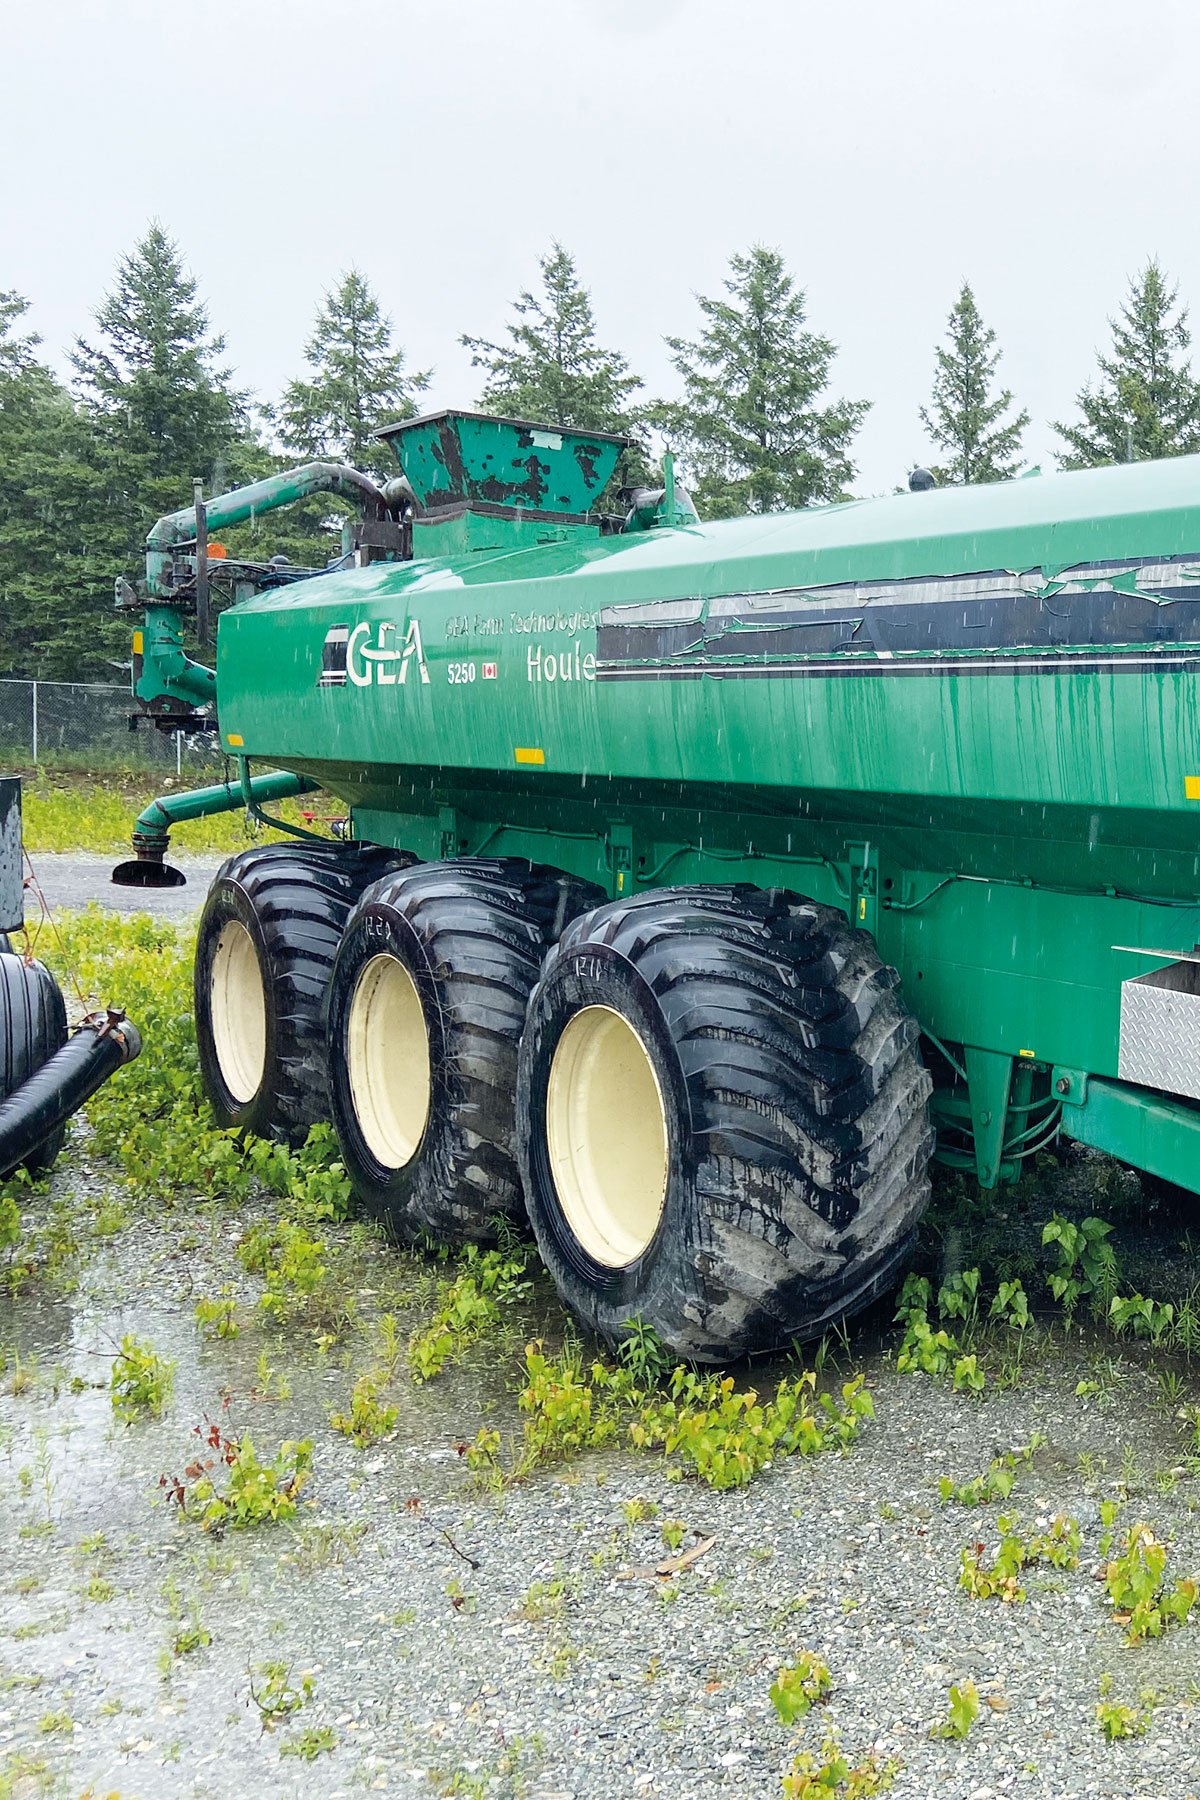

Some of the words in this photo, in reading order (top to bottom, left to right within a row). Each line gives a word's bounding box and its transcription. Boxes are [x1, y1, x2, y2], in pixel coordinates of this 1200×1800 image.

[509, 608, 597, 637] Technologies
[348, 620, 431, 687] GEA
[526, 641, 596, 682] Houle
[447, 662, 476, 684] 5250
